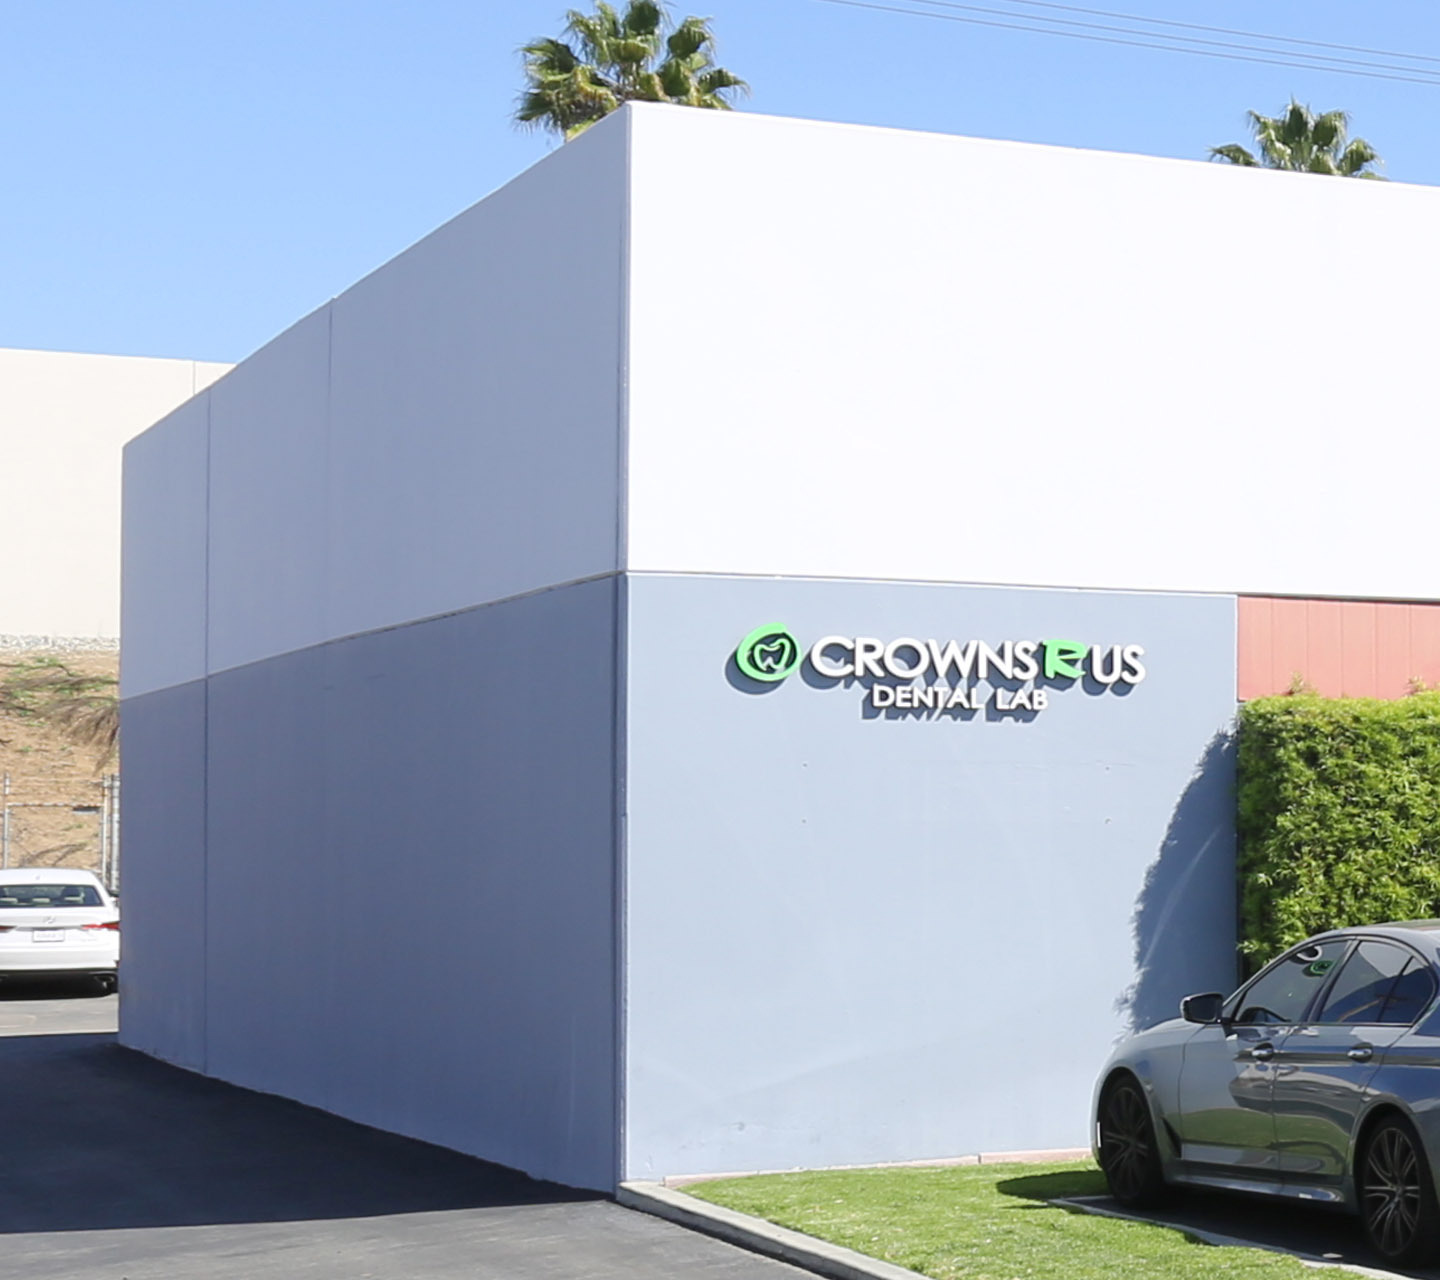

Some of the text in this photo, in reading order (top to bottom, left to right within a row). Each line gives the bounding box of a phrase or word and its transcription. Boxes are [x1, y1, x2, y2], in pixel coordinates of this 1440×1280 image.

[810, 635, 1147, 685] CROWNS R US
[872, 684, 1049, 711] DENTAL LAB
